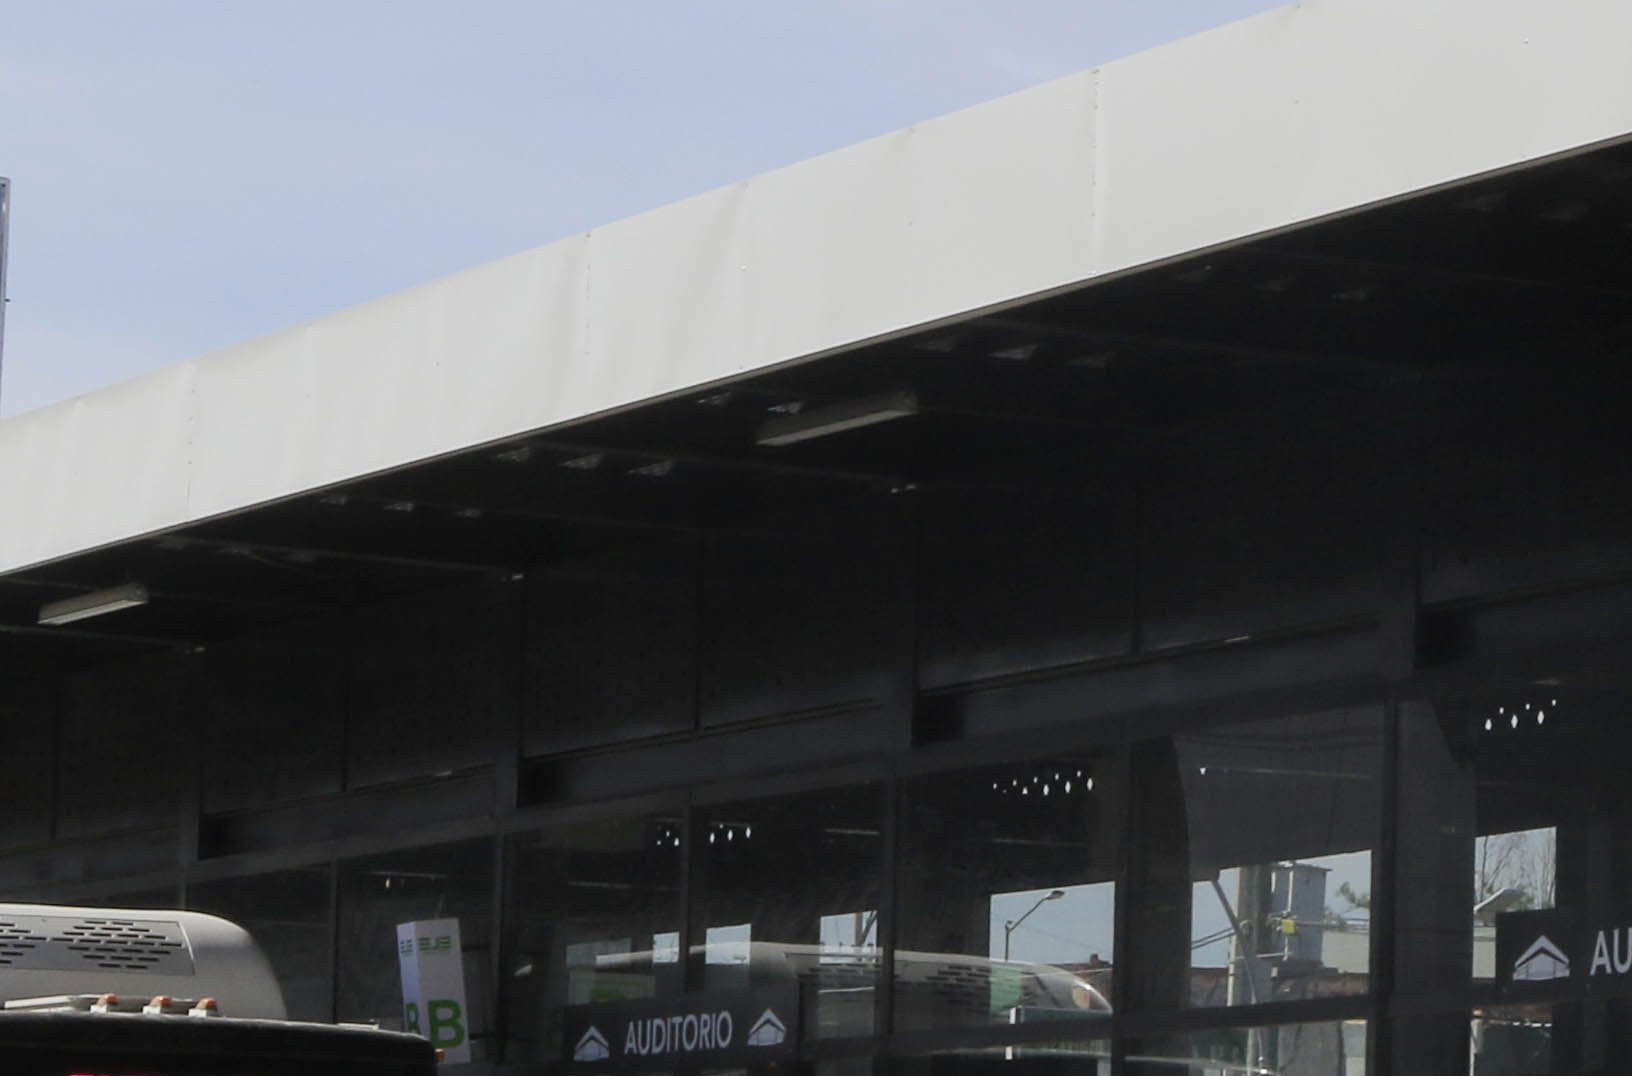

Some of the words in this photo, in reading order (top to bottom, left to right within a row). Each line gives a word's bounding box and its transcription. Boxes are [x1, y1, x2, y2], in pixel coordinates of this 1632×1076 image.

[1589, 927, 1632, 976] AU
[428, 1000, 465, 1048] B
[624, 1010, 733, 1056] AUDITORIO
